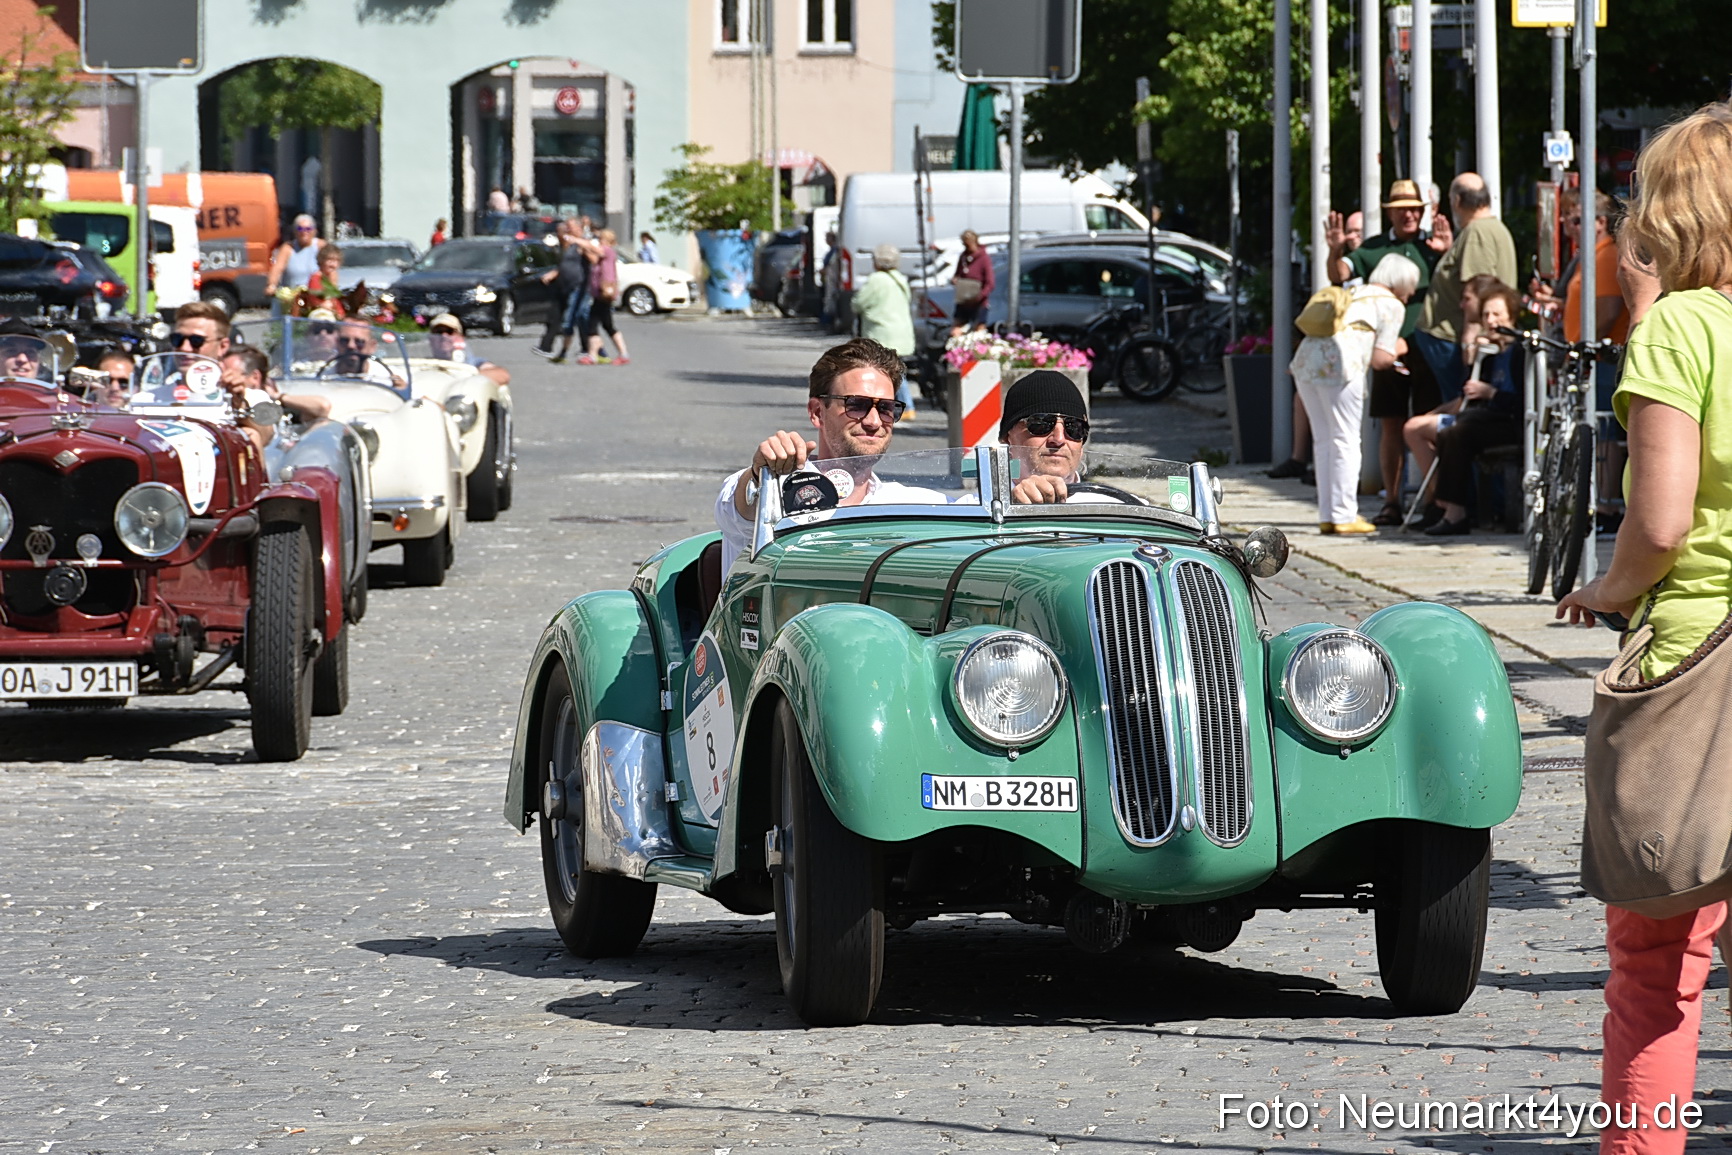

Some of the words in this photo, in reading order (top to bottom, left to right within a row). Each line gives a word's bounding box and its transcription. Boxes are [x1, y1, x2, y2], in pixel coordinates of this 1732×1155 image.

[201, 375, 207, 386] 6
[742, 612, 759, 624] HISCOX
[1, 667, 36, 693] OA
[56, 667, 72, 692] J
[80, 667, 132, 692] 91H
[706, 731, 717, 771] 8
[933, 780, 967, 806] NM
[985, 781, 1074, 807] B328H
